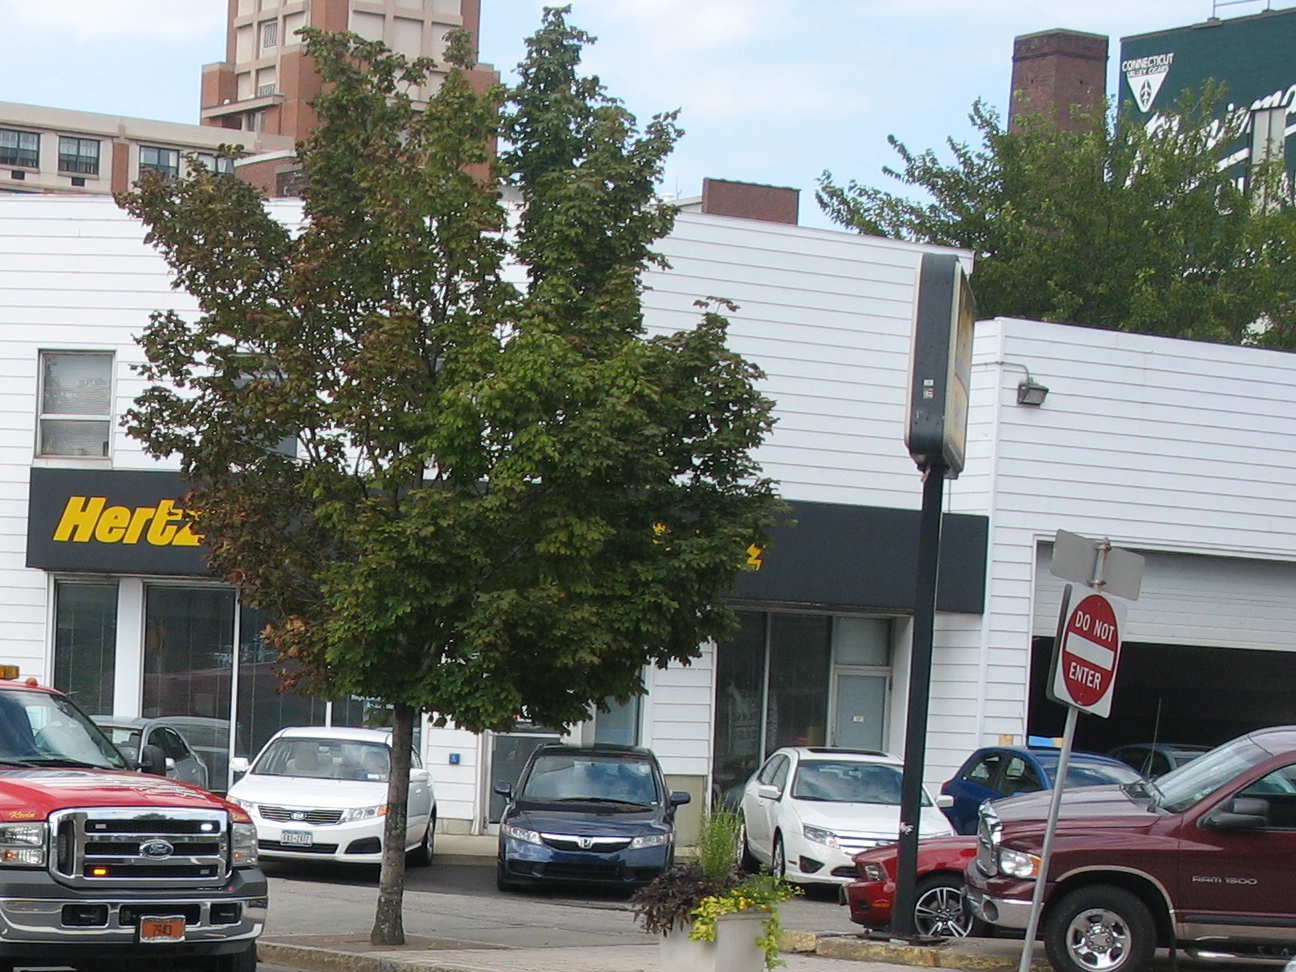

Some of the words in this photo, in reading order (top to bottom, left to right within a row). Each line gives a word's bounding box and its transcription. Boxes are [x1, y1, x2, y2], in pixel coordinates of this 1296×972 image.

[1122, 52, 1175, 72] CONNECTICUT
[53, 495, 205, 547] Hertz
[1075, 610, 1091, 631] DO
[1093, 619, 1115, 643] NOT
[1068, 661, 1102, 691] ENTER
[1191, 875, 1222, 883] RAM
[1224, 876, 1258, 885] 1500
